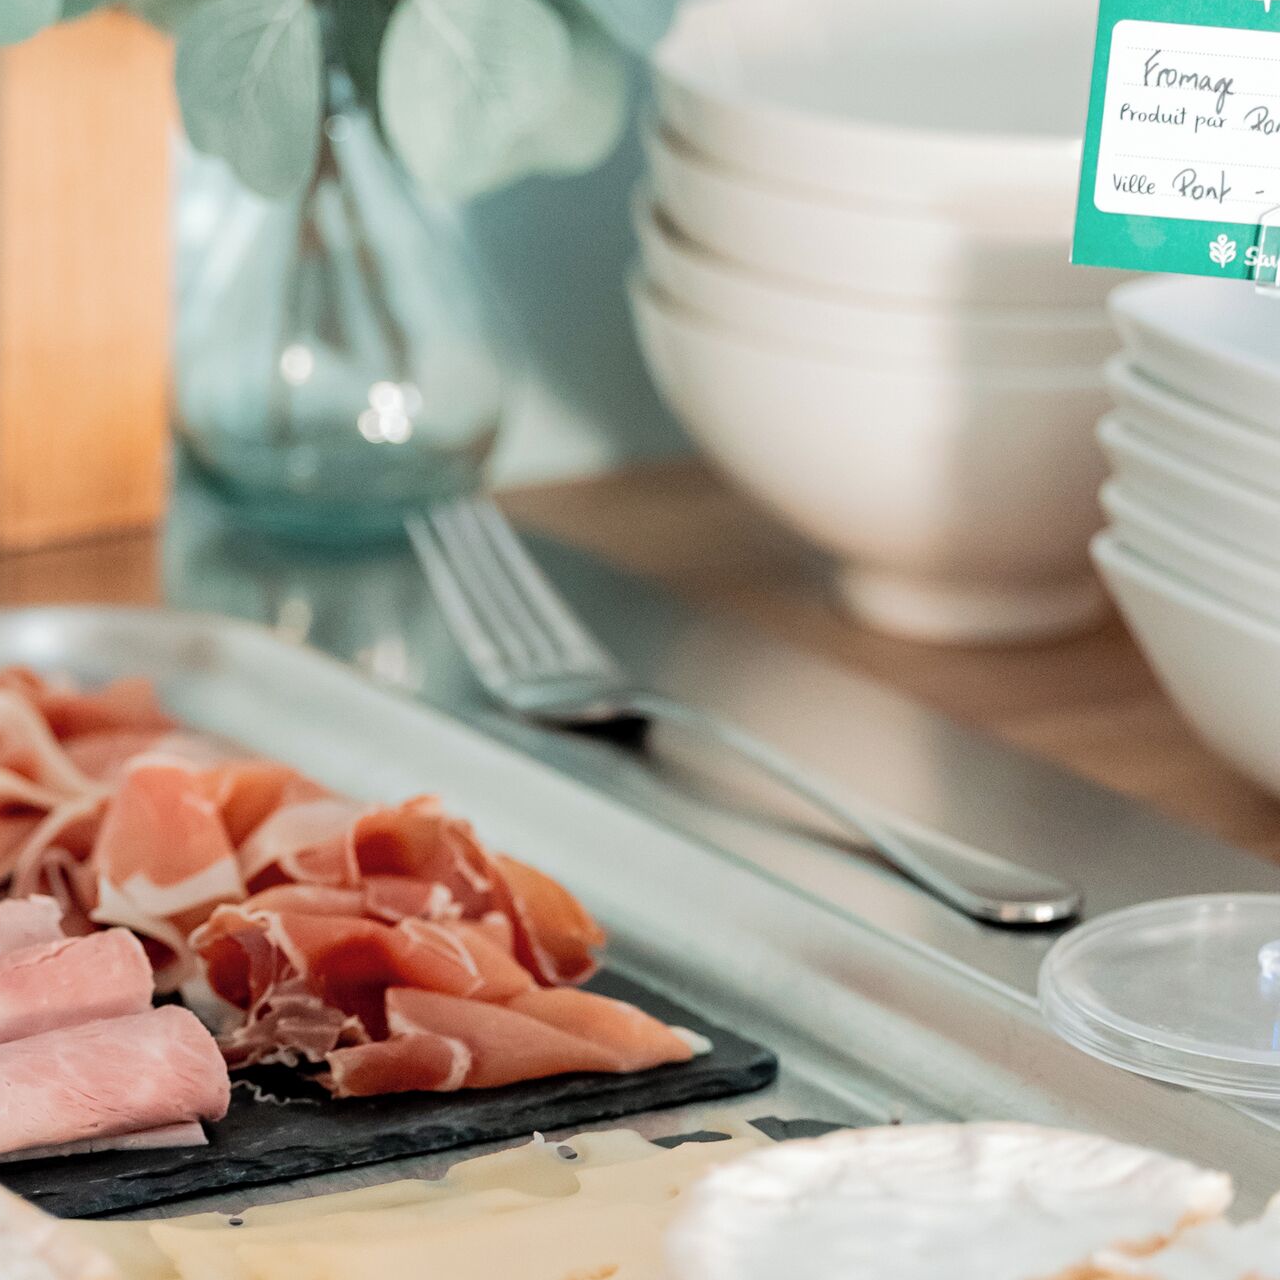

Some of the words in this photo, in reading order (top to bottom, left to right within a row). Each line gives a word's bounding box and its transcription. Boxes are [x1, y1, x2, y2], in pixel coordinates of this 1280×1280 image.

[1143, 49, 1234, 115] Fromage
[1120, 103, 1187, 125] Produit
[1195, 114, 1228, 134] par
[1113, 173, 1156, 195] Ville
[1172, 168, 1232, 205] Pont
